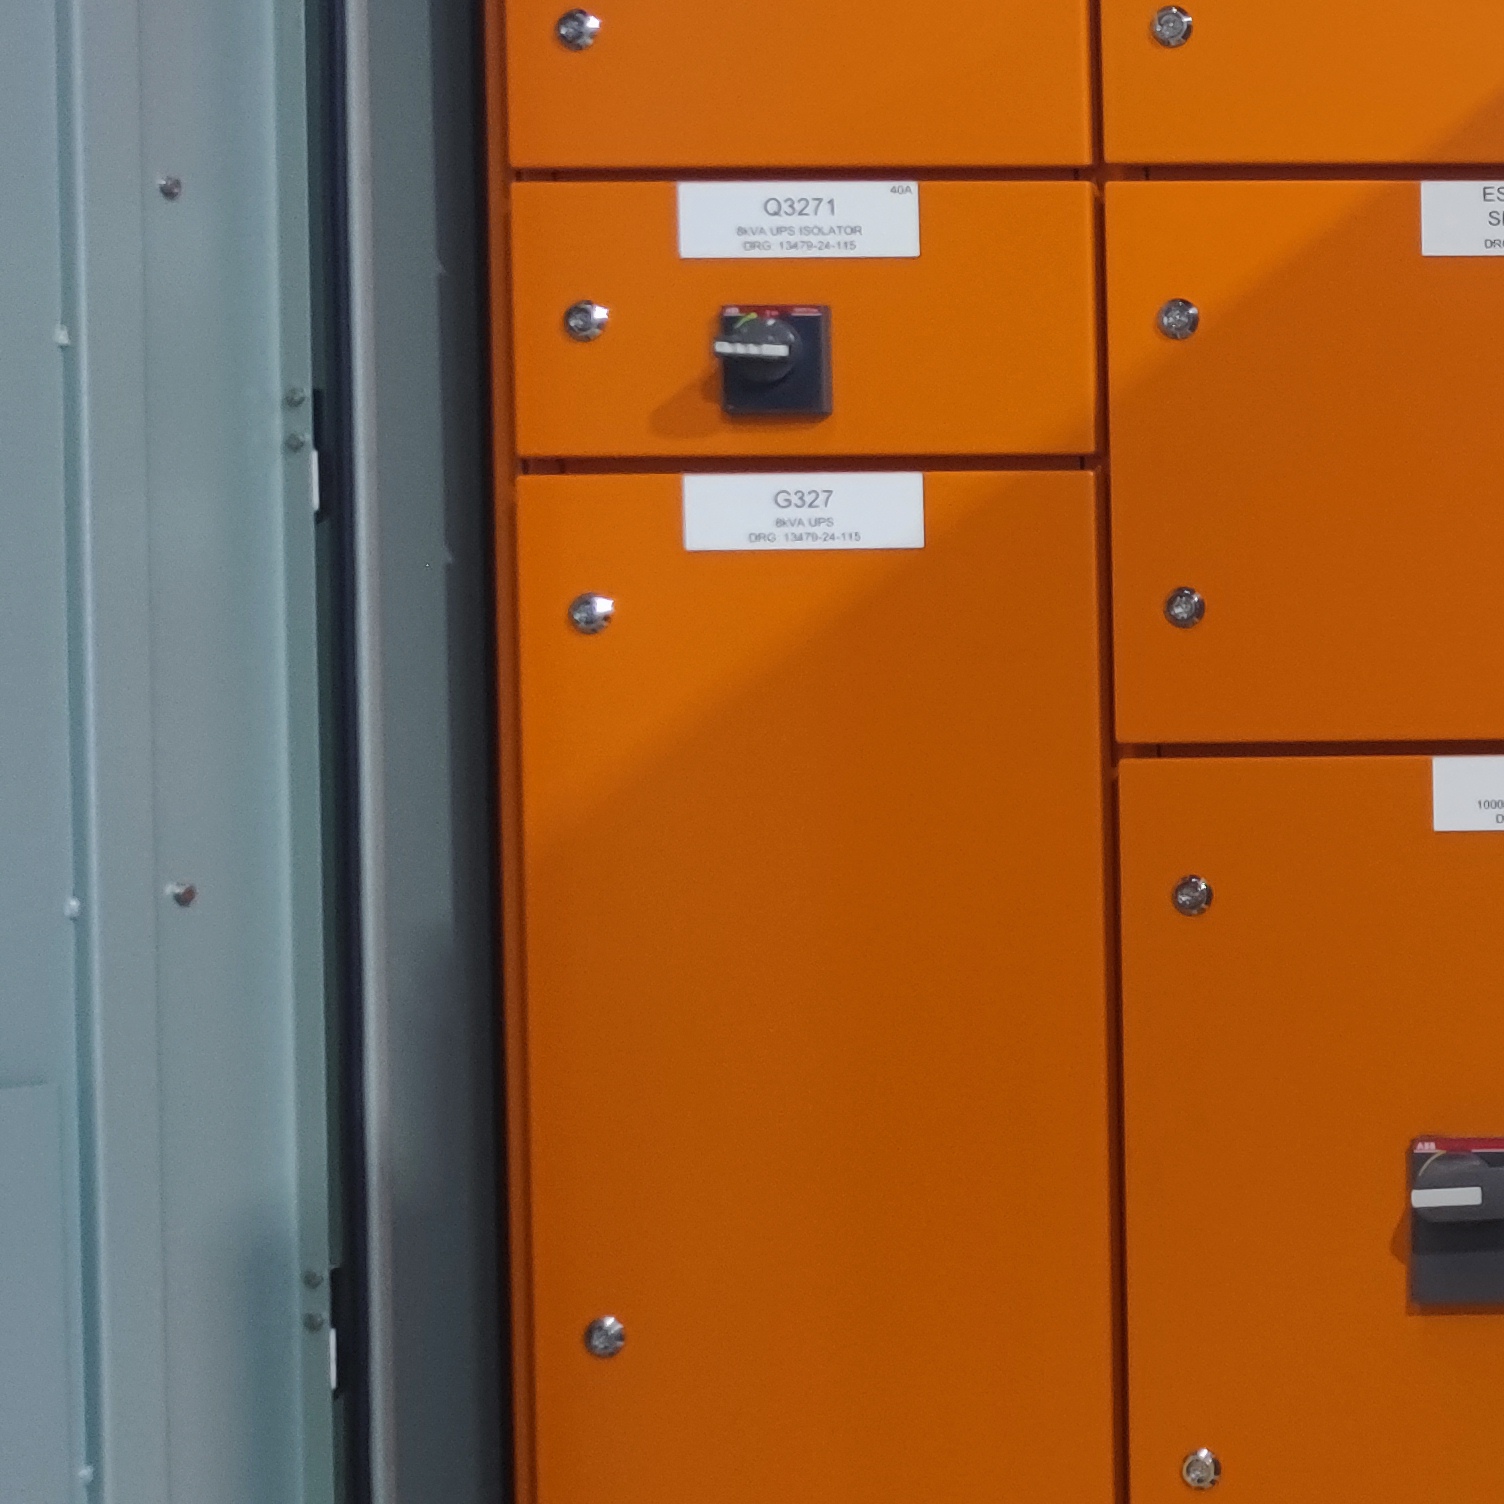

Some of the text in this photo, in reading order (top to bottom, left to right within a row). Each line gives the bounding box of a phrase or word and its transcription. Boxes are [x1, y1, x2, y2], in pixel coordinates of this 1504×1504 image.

[890, 185, 913, 195] 40A
[763, 197, 836, 218] Q3271
[770, 225, 796, 236] UPS
[799, 225, 863, 236] ISOLATOR
[774, 489, 834, 509] G327
[808, 517, 834, 528] UPS
[1416, 1142, 1436, 1150] ABB
